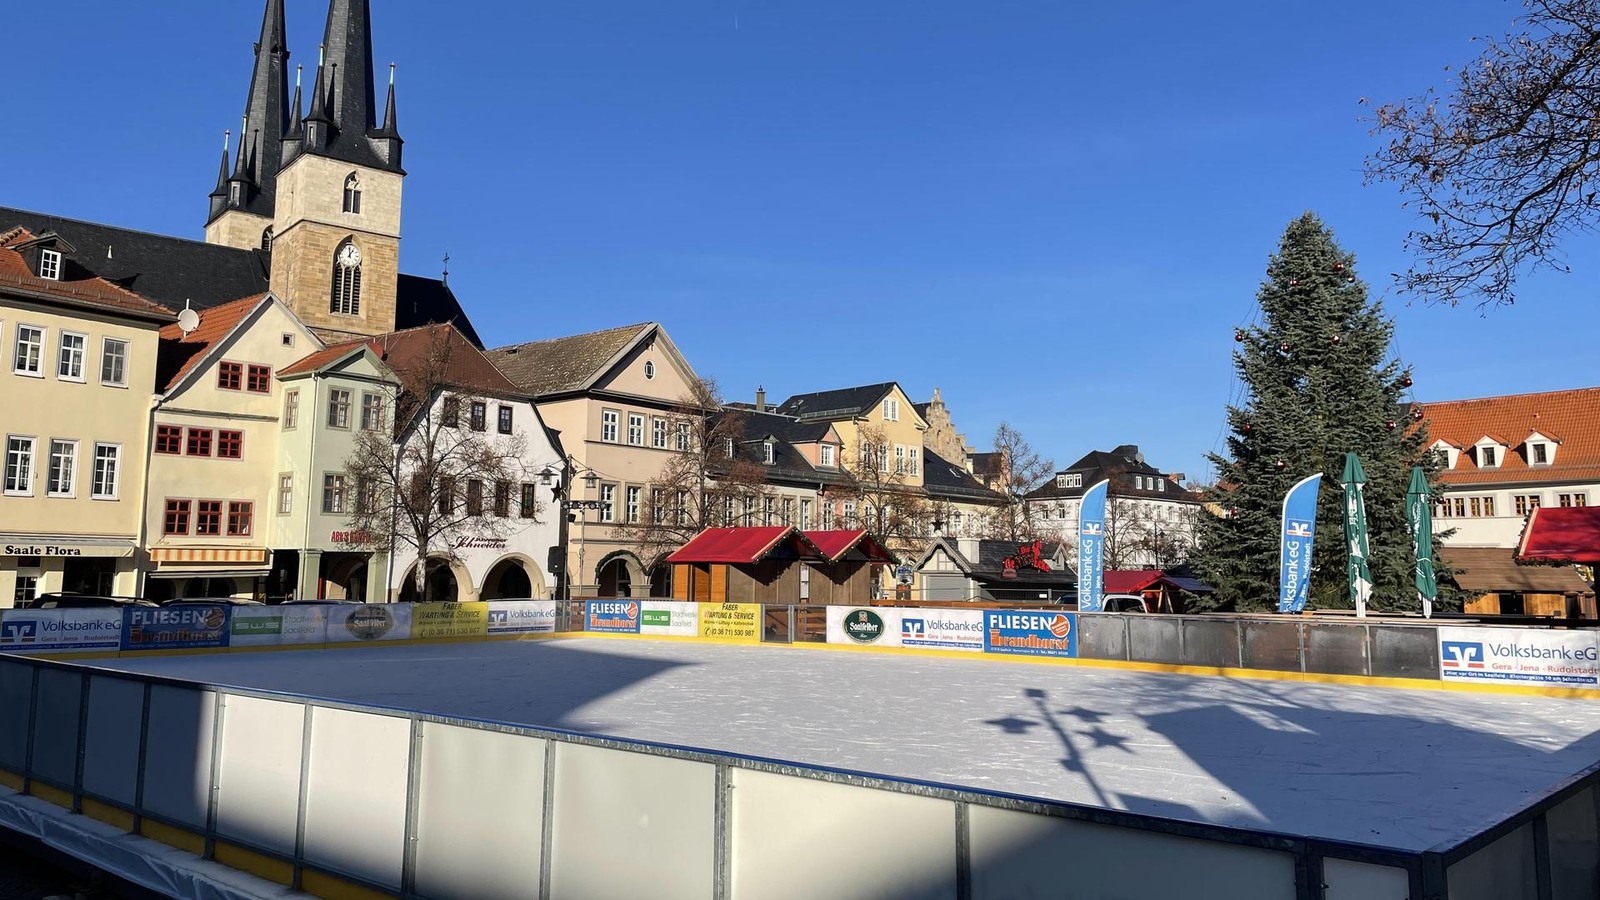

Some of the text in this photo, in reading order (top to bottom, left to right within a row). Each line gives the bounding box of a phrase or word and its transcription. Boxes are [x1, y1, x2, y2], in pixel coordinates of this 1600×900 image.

[5, 545, 81, 555] Saale Flora
[1081, 539, 1093, 609] Volksbank eG
[1283, 541, 1299, 612] olksbank eG
[442, 602, 463, 610] FABER
[590, 602, 628, 614] FLIESEN
[722, 602, 738, 611] FABER
[131, 610, 206, 625] FLIESEN
[456, 610, 480, 618] SERVICE
[510, 609, 555, 619] Volksbank eG
[704, 610, 728, 619] WARTUNG
[733, 611, 755, 620] SERVICE
[41, 620, 121, 631] Volksbank eG
[926, 620, 983, 632] Volksbank eG
[989, 614, 1052, 630] FLIESEN
[1489, 643, 1597, 661] Volksbank eG
[1492, 663, 1512, 671] Gera
[1519, 664, 1540, 672] Jena
[1547, 665, 1598, 674] Rudolstadt
